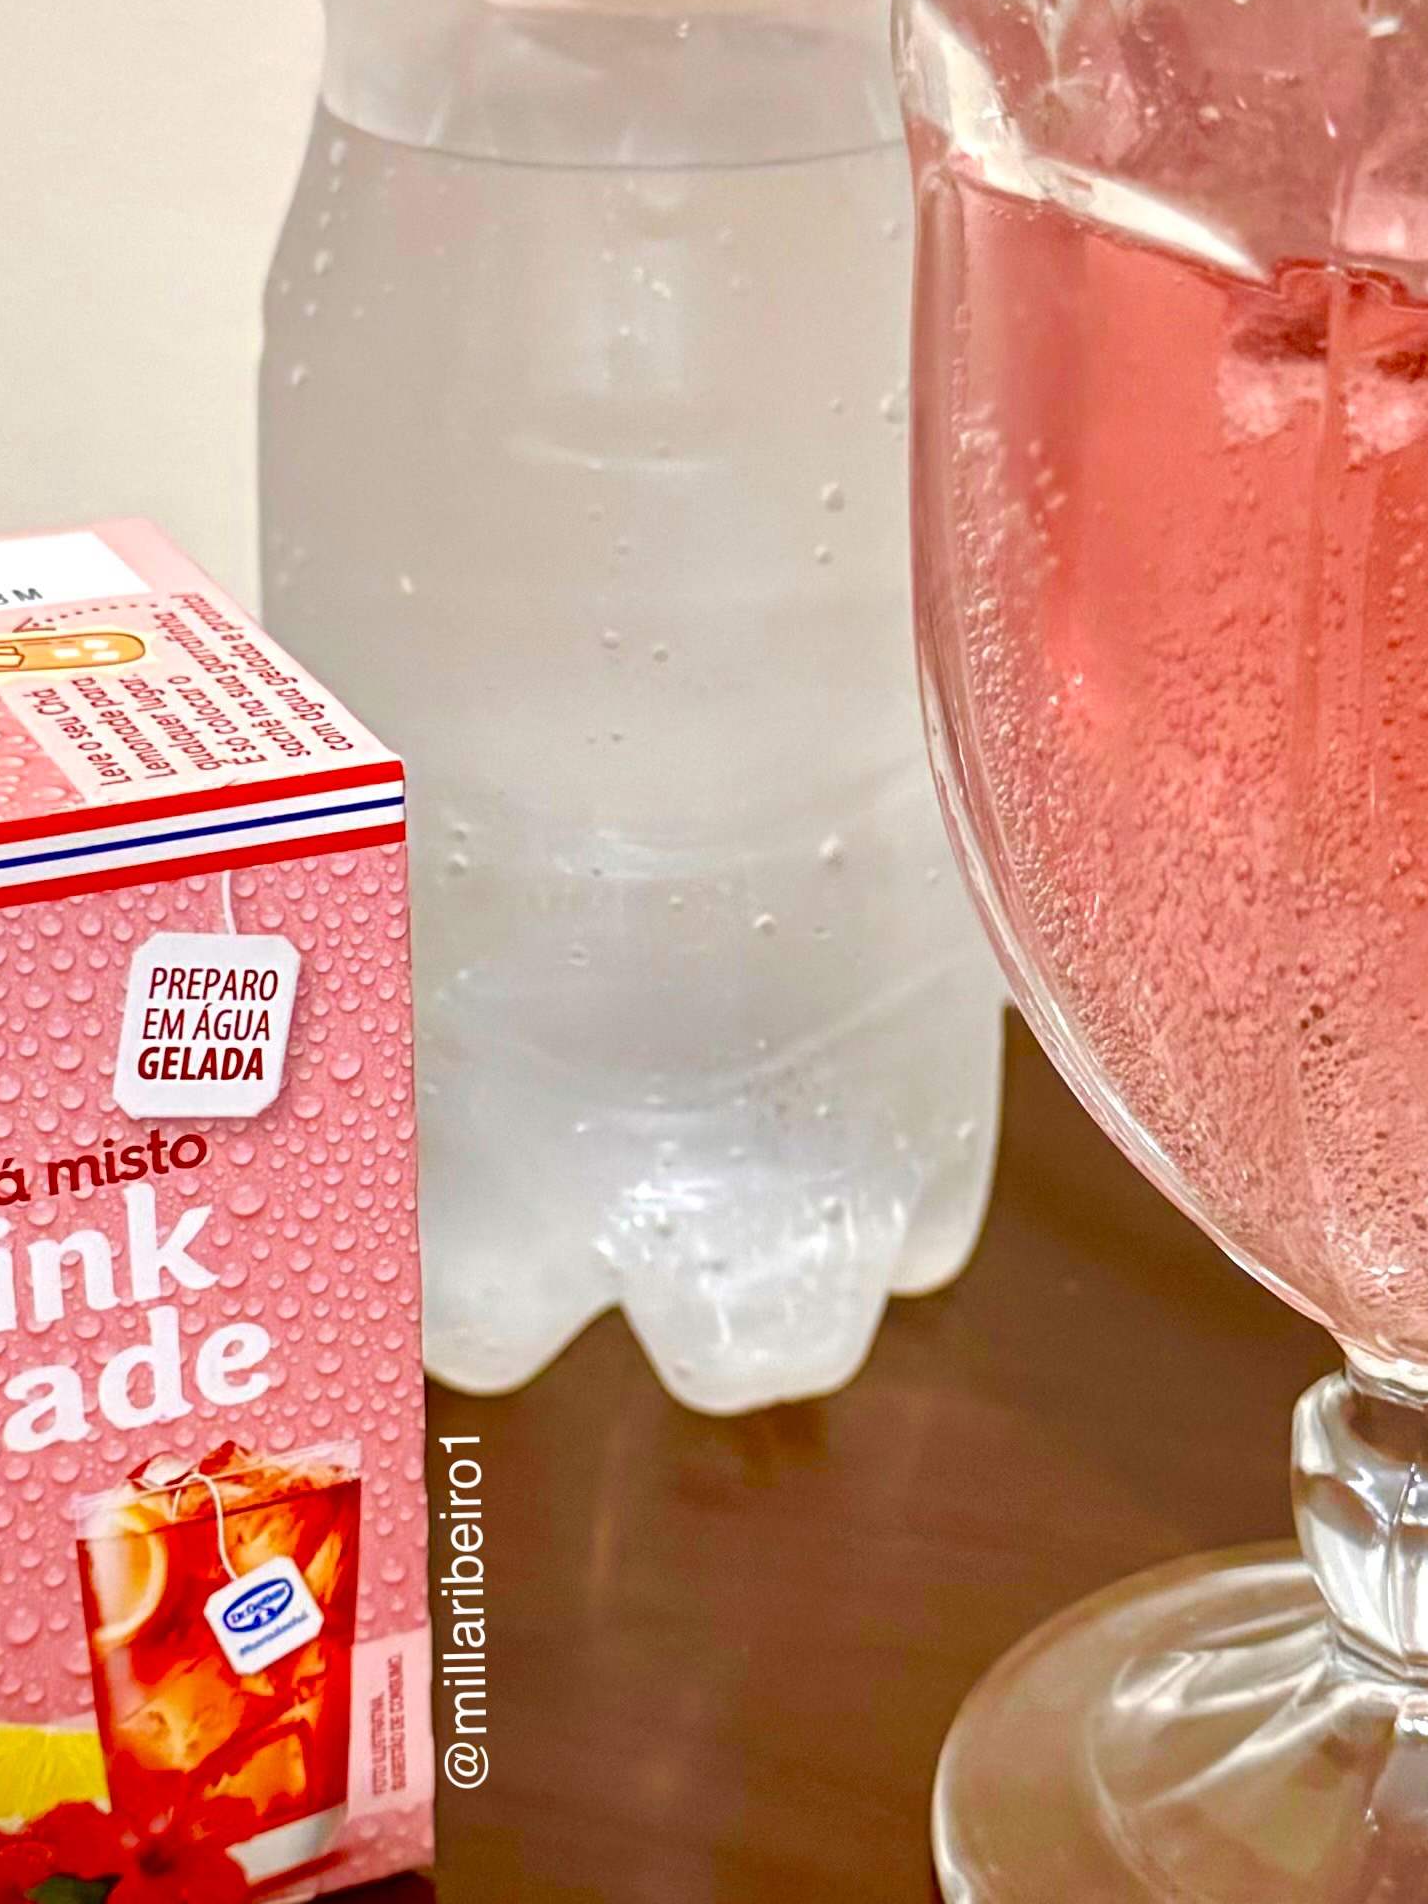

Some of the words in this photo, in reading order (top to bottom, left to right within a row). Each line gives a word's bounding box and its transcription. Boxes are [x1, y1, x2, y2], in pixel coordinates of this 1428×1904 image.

[12, 587, 44, 602] M
[153, 611, 238, 674] garrafinha
[221, 633, 245, 642] e
[167, 675, 192, 685] o
[229, 642, 299, 687] gelada
[23, 687, 71, 715] Chá
[72, 676, 124, 708] para
[118, 673, 168, 712] lugar.
[214, 674, 254, 698] sua
[175, 688, 239, 735] colocar
[238, 699, 274, 719] na
[274, 688, 326, 722] água
[55, 715, 94, 739] seu
[151, 713, 230, 772] qualquer
[311, 722, 354, 752] com
[77, 741, 103, 751] o
[97, 709, 179, 780] Lemonade
[216, 736, 257, 753] só
[87, 752, 133, 787] Leve
[148, 967, 279, 1001] PREPARO
[142, 1008, 186, 1040] EM
[192, 1002, 271, 1041] ÁGUA
[137, 1046, 264, 1081] GELADA
[47, 1129, 208, 1199] misto
